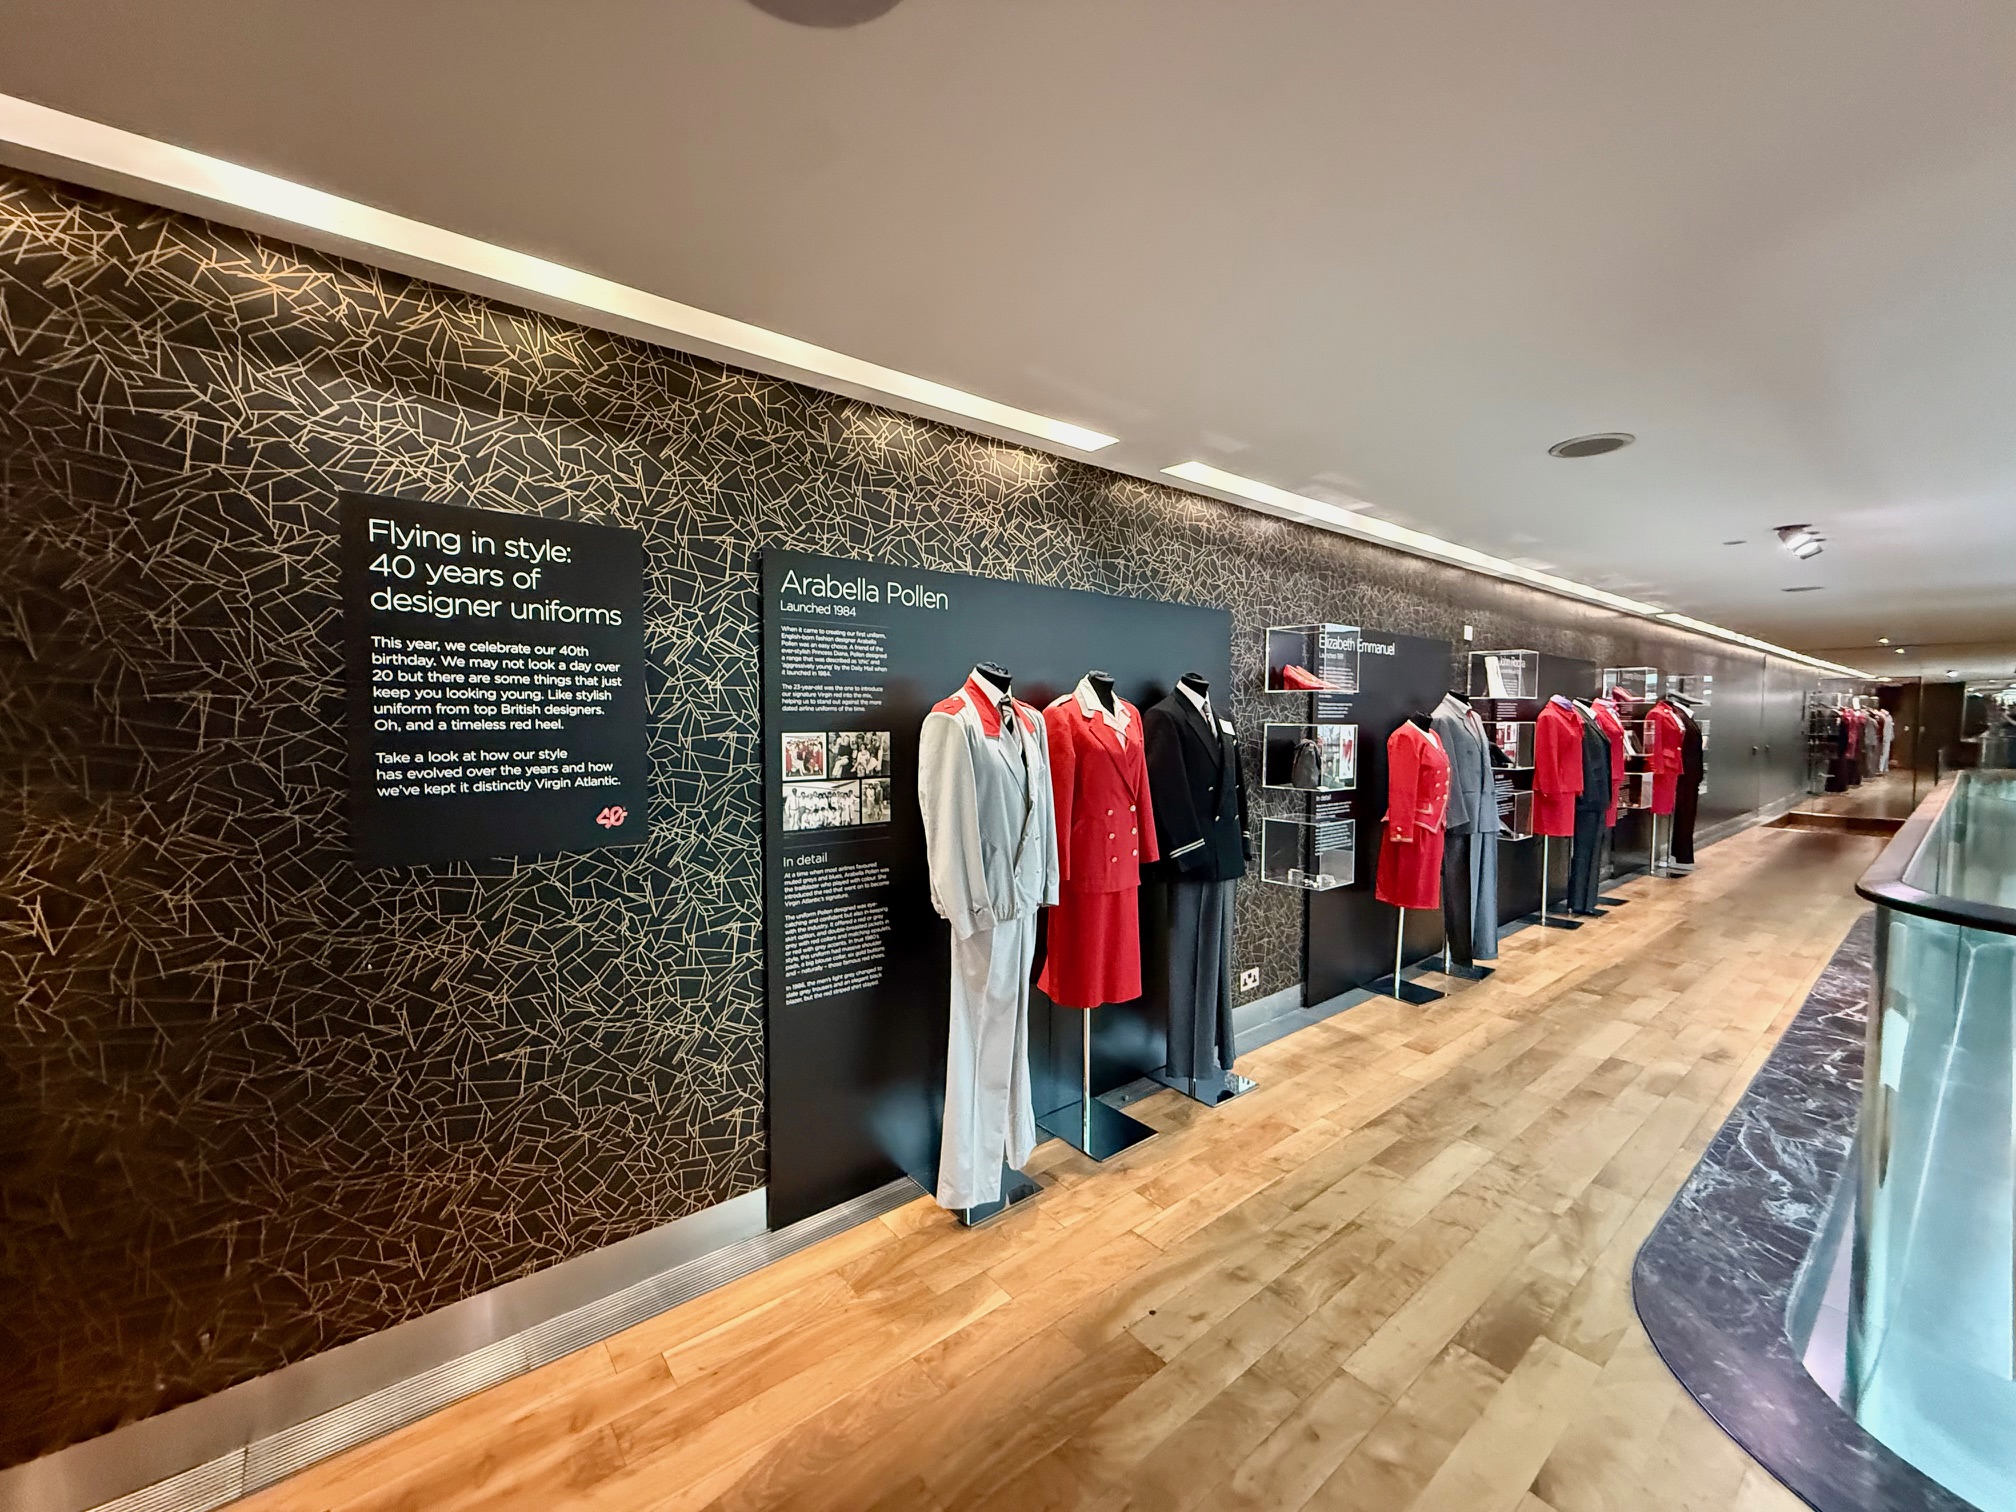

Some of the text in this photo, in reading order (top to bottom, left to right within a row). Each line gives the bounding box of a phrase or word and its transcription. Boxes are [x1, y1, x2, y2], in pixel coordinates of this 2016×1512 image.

[368, 518, 572, 564] Flying in style:
[368, 553, 542, 590] 40 years of
[780, 569, 948, 610] Arabella Pollen
[370, 586, 622, 626] designer uniforms
[780, 599, 857, 617] Launched 1984
[370, 635, 589, 657] This year, we celebrate our 40th
[1318, 634, 1395, 656] Eizabeth Emmanuel
[371, 652, 621, 674] birthday. We may not look a day over
[372, 669, 623, 688] 20 but there are some things that just
[373, 685, 612, 702] keep you looking young. Like stylish
[373, 702, 605, 717] uniform from top British designers.
[374, 718, 564, 732] Oh, and a timeless red heel.
[375, 748, 568, 764] Take a look at how our style
[376, 761, 614, 781] has evolved over the years and how
[424, 782, 456, 796] kept
[460, 781, 470, 793] it
[472, 778, 532, 792] distinctly
[534, 777, 571, 790] Virgin
[574, 775, 621, 788] Atlantic.
[782, 852, 828, 868] In detail
